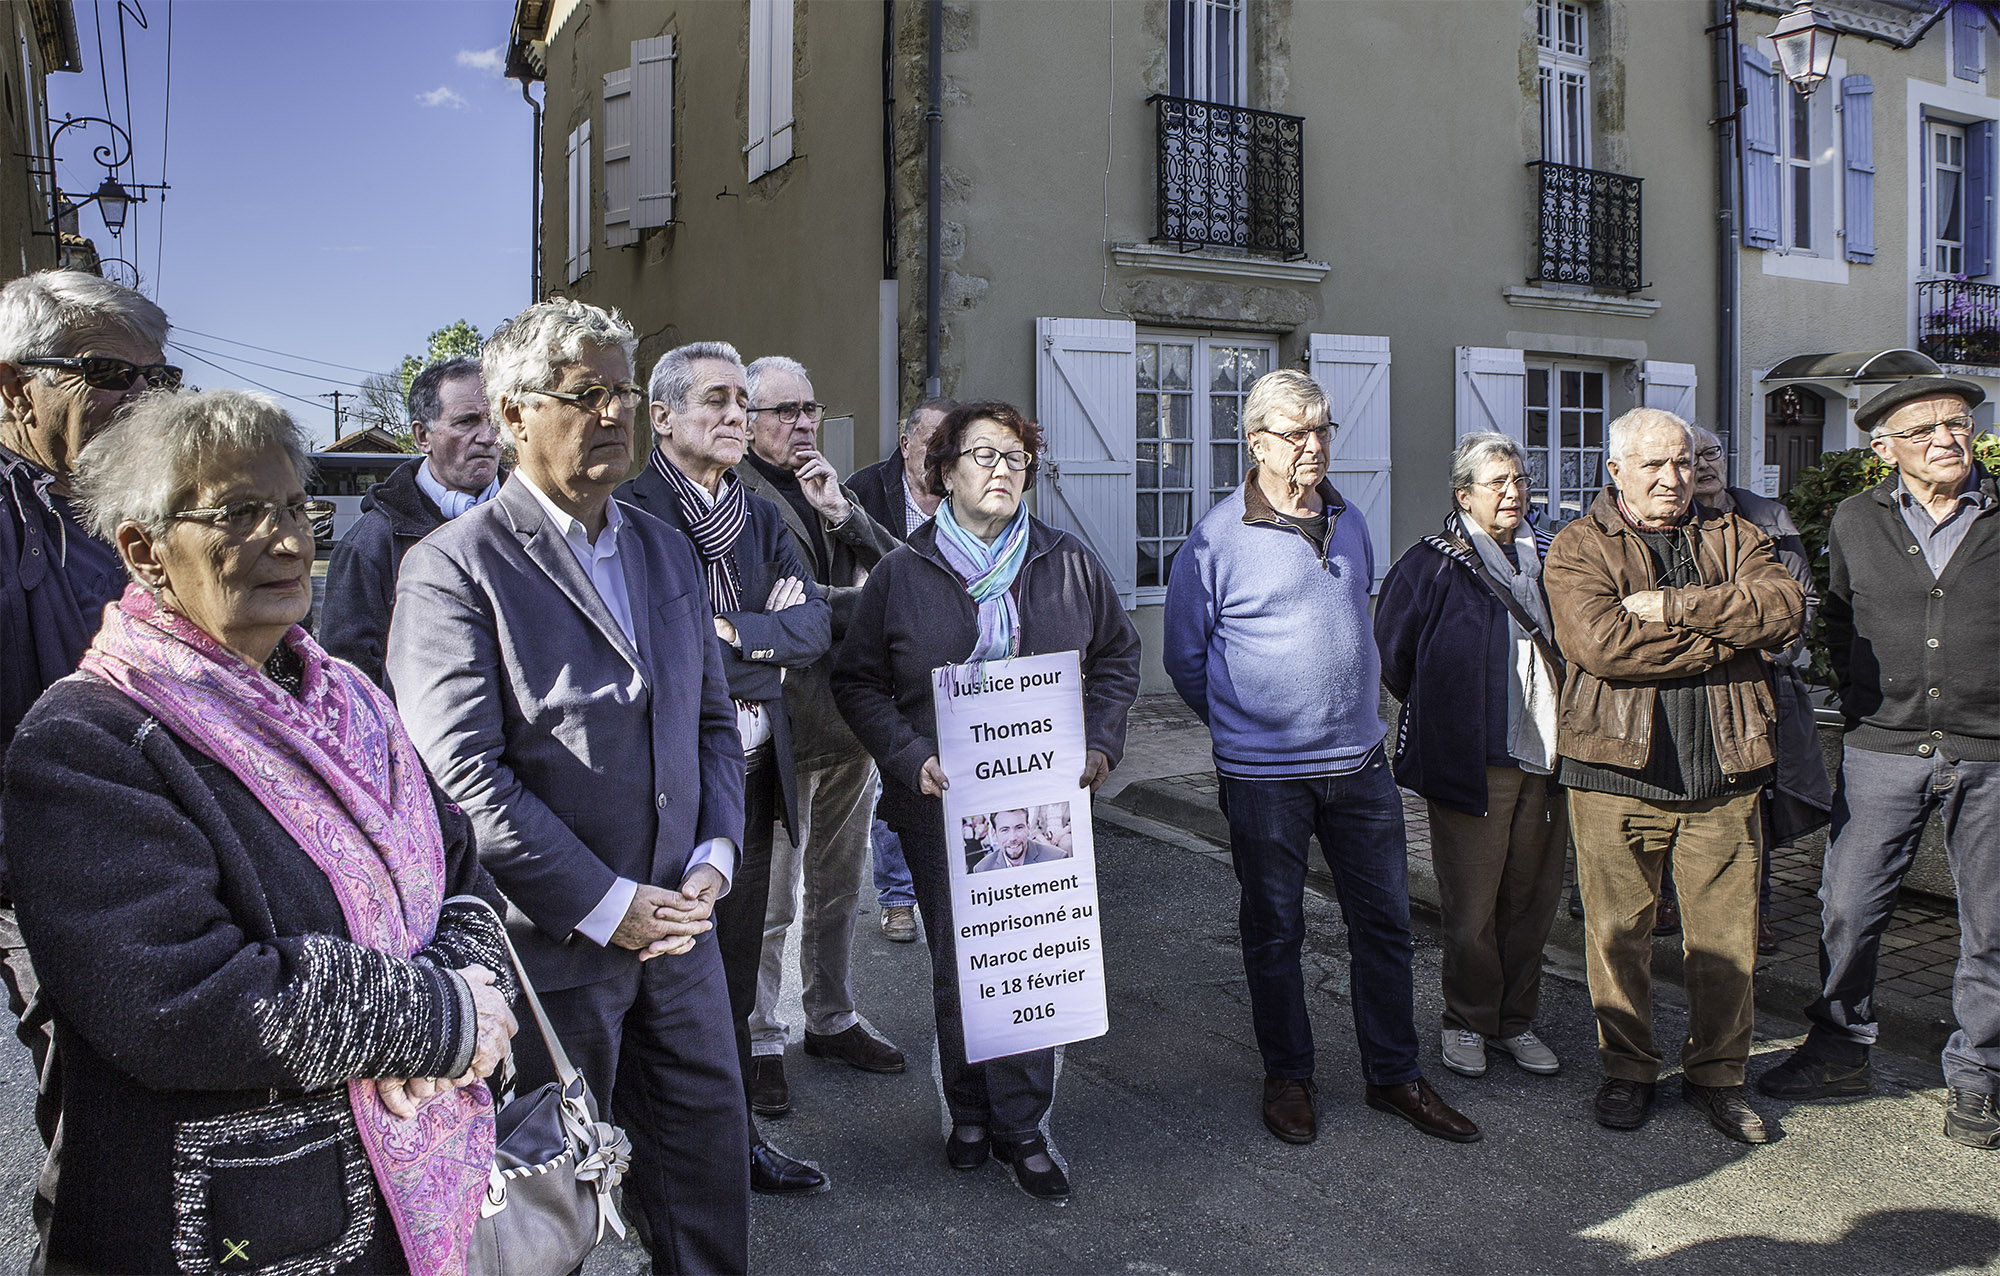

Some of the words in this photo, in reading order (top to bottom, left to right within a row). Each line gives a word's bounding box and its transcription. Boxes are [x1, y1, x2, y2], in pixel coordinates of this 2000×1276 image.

[953, 675, 1014, 698] Justice
[1019, 670, 1062, 693] pour
[969, 718, 1053, 744] Thomas
[975, 750, 1055, 780] GALLAY
[970, 875, 1079, 907] injustement
[960, 907, 1067, 939] emprisonné
[1070, 905, 1093, 920] au
[970, 949, 1028, 971] Maroc
[1032, 936, 1091, 963] depuis
[979, 983, 996, 1000] le
[1001, 977, 1023, 996] 18
[1026, 967, 1086, 991] février
[1012, 1002, 1056, 1025] 2016
